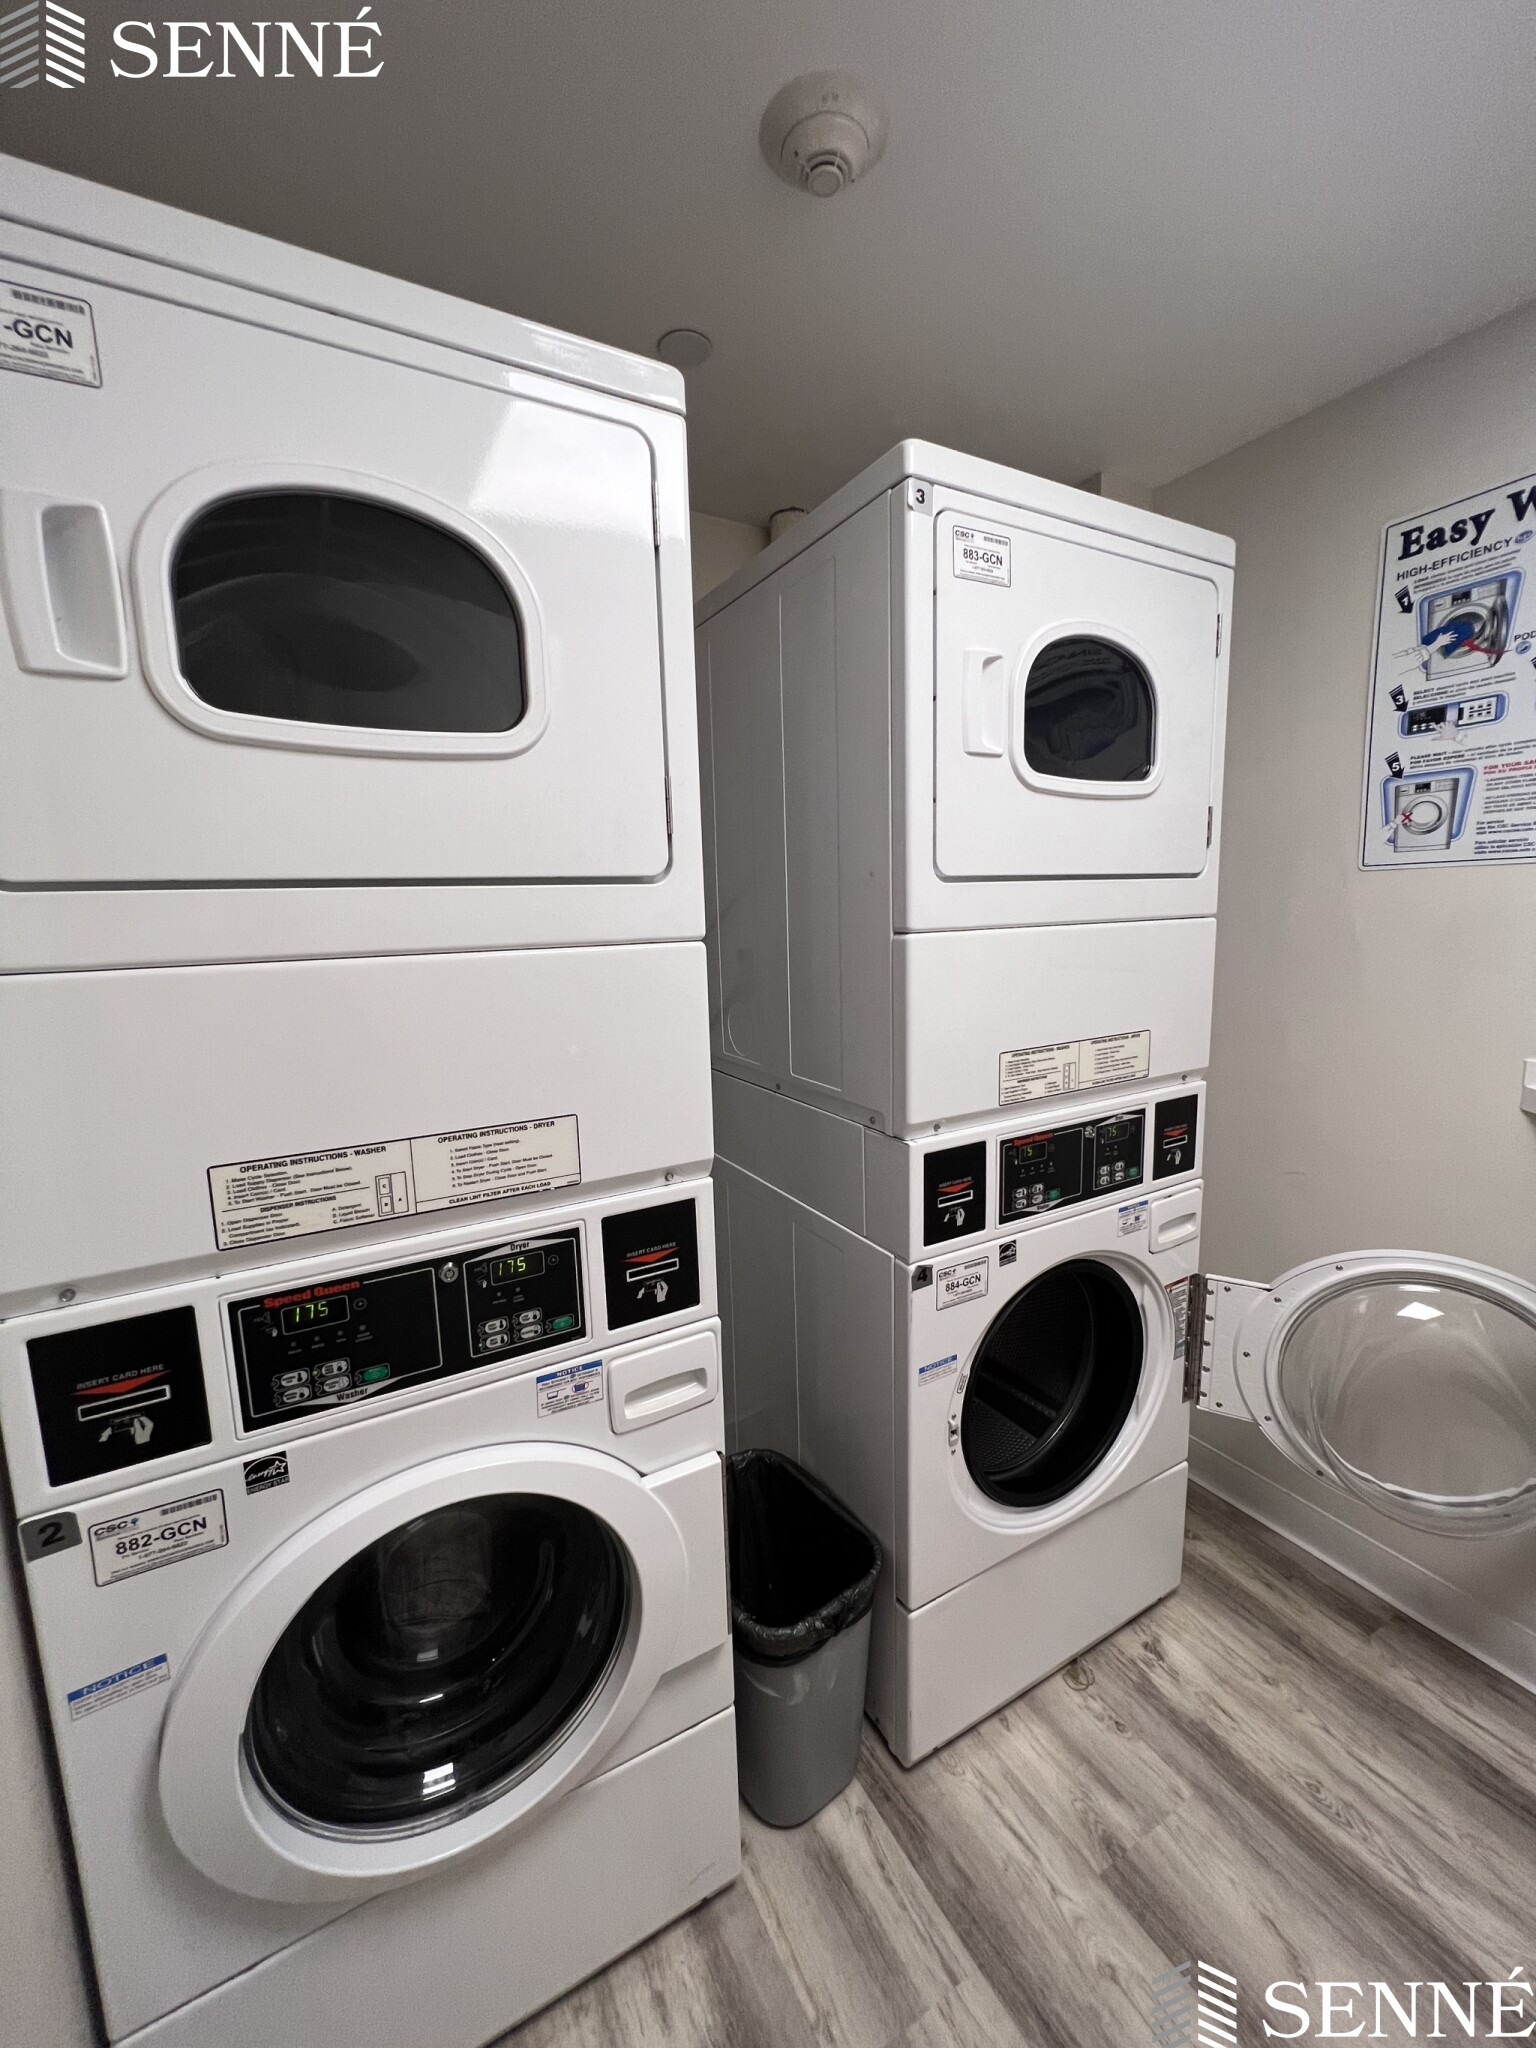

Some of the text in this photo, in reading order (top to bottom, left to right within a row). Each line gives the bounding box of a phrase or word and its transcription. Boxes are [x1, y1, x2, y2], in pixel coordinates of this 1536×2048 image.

[916, 488, 925, 504] 3
[955, 529, 970, 538] CSC
[1398, 508, 1495, 560] Easy
[963, 548, 1003, 566] 883-GCN
[1397, 537, 1513, 581] HIGH-EFFICIENCY
[1396, 695, 1404, 705] 3
[1392, 763, 1399, 771] 5
[437, 1131, 477, 1143] OPERATING
[479, 1124, 527, 1137] INSTRUCTIONS
[533, 1120, 554, 1129] DRYER
[239, 1159, 288, 1173] OPERATING
[289, 1151, 348, 1166] INSTRUCTIONS
[353, 1145, 386, 1156] WASHER
[448, 1196, 468, 1204] CLEAN
[482, 1190, 501, 1198] FILTER
[502, 1186, 520, 1194] AFTER
[510, 1242, 530, 1251] Dryer
[626, 1241, 676, 1258] INSERT CARD HERE
[499, 1257, 526, 1276] 175
[917, 1269, 928, 1282] 4
[945, 1273, 981, 1292] 884-GCN
[263, 1280, 361, 1309] Speed Queen
[295, 1301, 329, 1323] 175
[76, 1363, 165, 1390] INSERT CARD HERE
[556, 1365, 584, 1377] NOTICE
[336, 1386, 369, 1402] Washer
[38, 1521, 66, 1548] 2
[94, 1520, 128, 1537] CSC
[115, 1516, 208, 1556] 882-GCN
[83, 1659, 156, 1695] NOTICE
